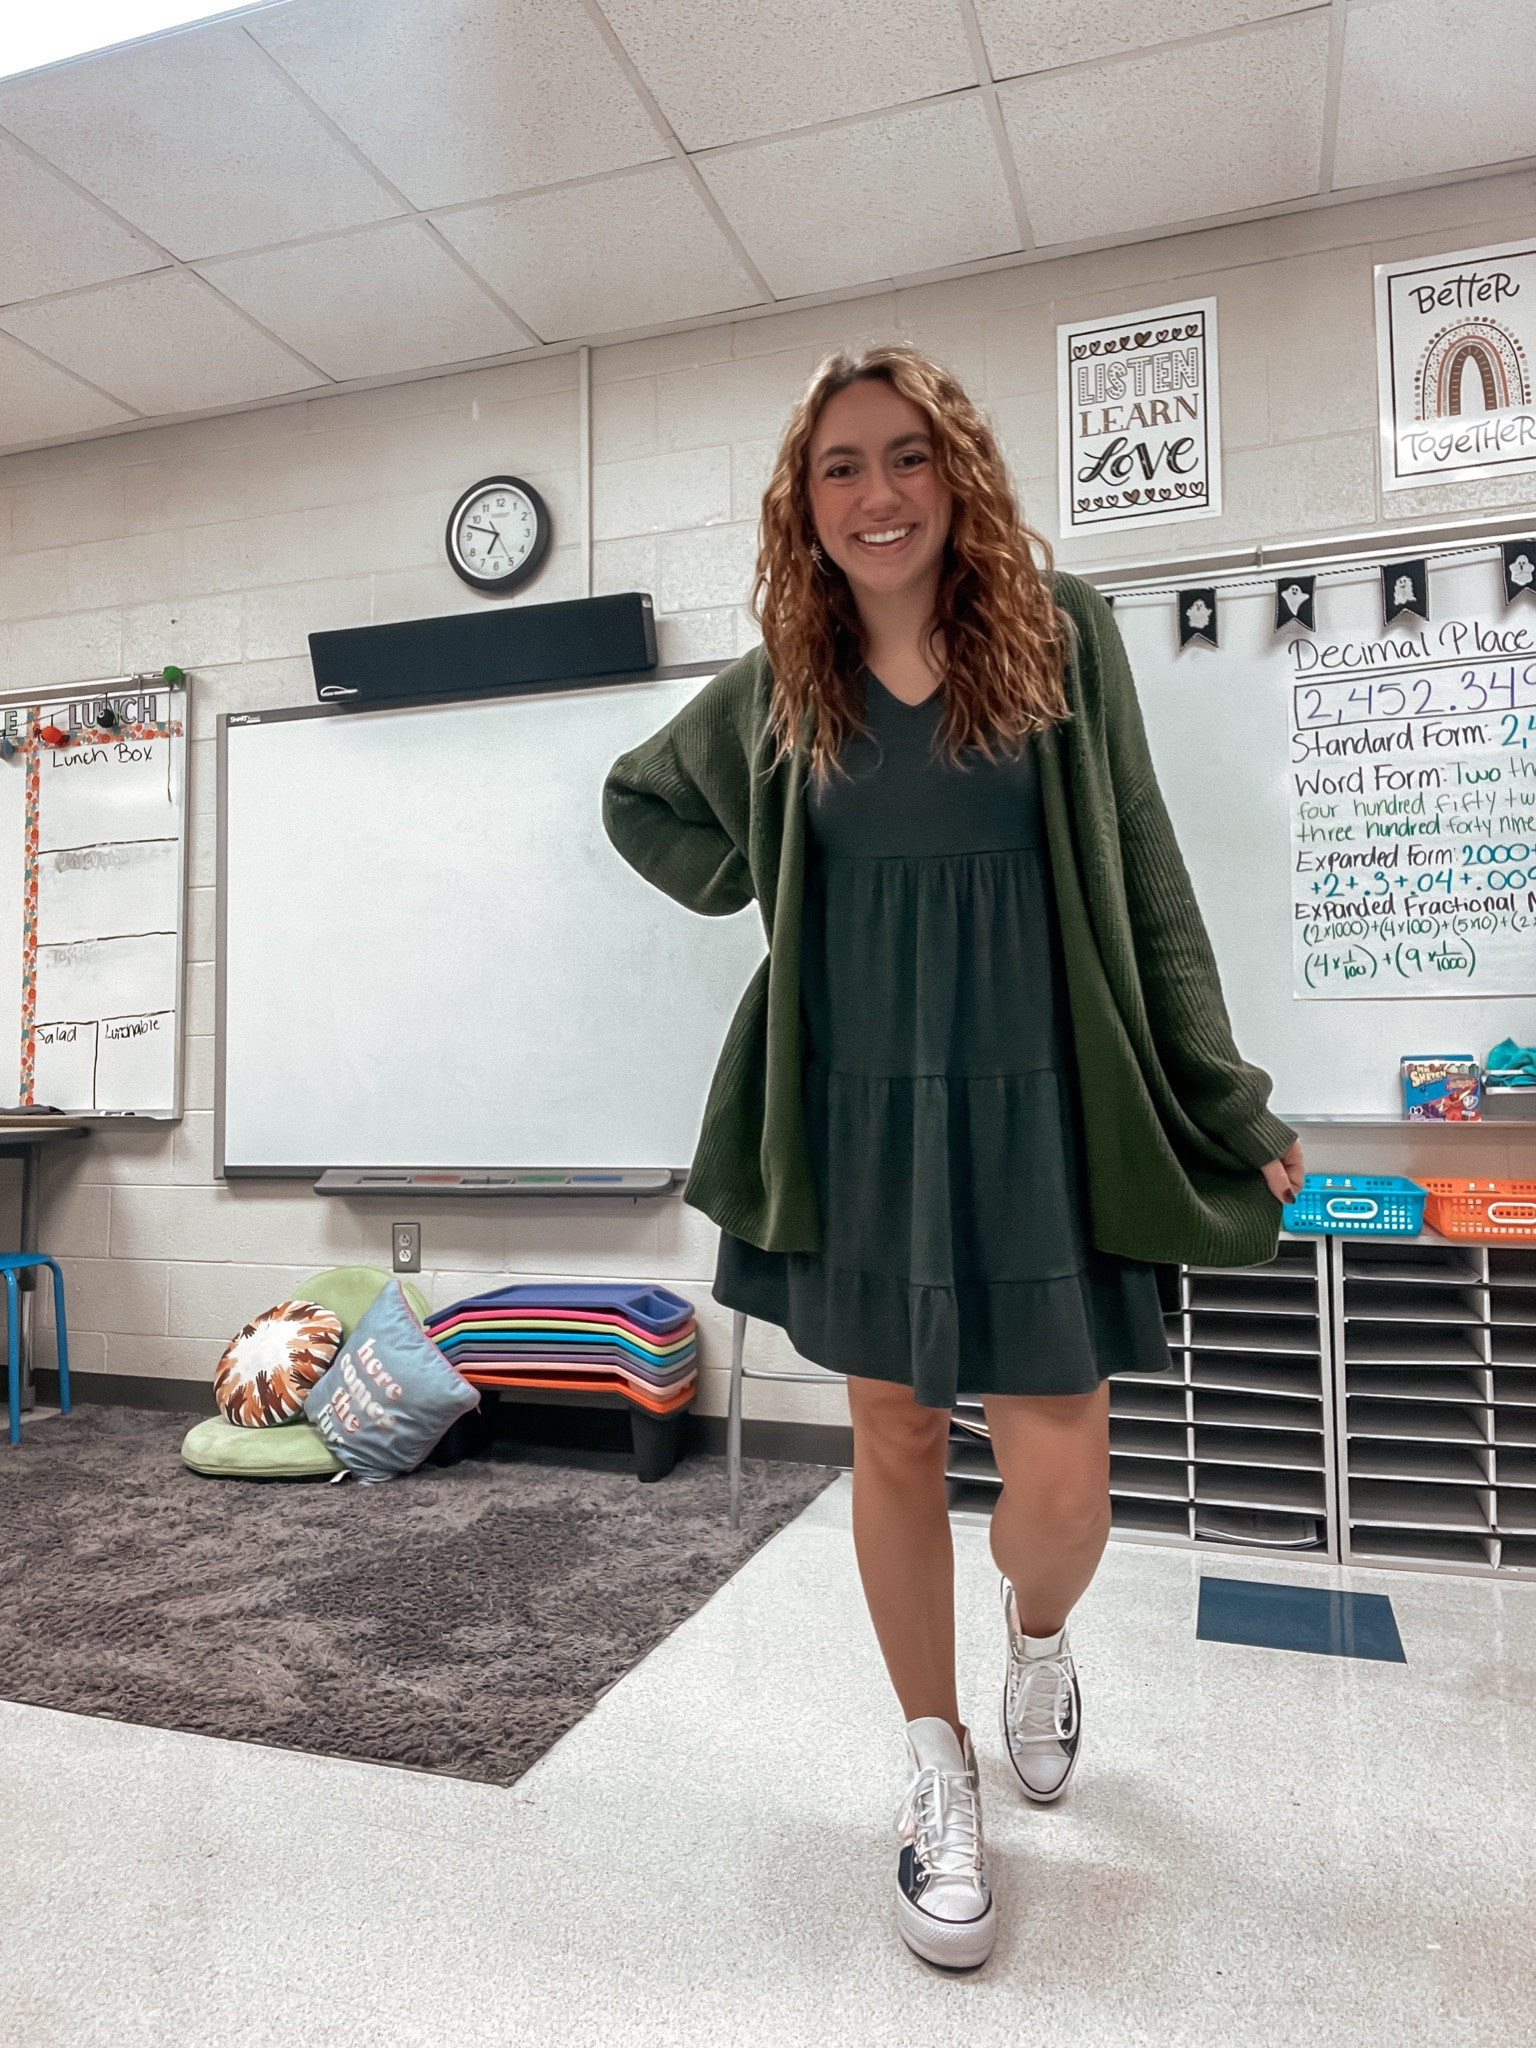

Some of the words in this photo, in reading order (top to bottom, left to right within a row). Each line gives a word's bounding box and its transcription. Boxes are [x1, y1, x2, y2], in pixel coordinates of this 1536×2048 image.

[1077, 347, 1199, 406] LISTEN
[1078, 393, 1199, 438] LEARN
[482, 504, 490, 513] 11
[496, 498, 506, 508] 12
[513, 502, 518, 511] 1
[472, 515, 482, 525] 10
[521, 512, 528, 521] 2
[466, 532, 473, 541] 9
[525, 529, 531, 538] 3
[469, 548, 476, 557] 8
[519, 545, 525, 554] 4
[480, 558, 486, 568] 7
[493, 562, 499, 571] 6
[508, 557, 515, 567] 5
[1288, 632, 1431, 671] Decimal
[1439, 621, 1534, 655] Place
[1292, 722, 1414, 764] Standard
[52, 747, 108, 768] Lunch
[114, 743, 152, 764] Box
[1295, 766, 1364, 797] Word
[1446, 761, 1500, 785] Two
[1297, 801, 1339, 820] four
[1353, 791, 1426, 817] hundred
[1435, 790, 1496, 815] fifty
[1297, 822, 1355, 843] three
[1365, 812, 1440, 839] hundred
[1446, 815, 1491, 838] forty
[1296, 843, 1399, 873] Expanded
[1295, 892, 1396, 921] Expanded
[1404, 892, 1516, 918] Fractional
[37, 1025, 77, 1044] Salad
[356, 1337, 402, 1400] here
